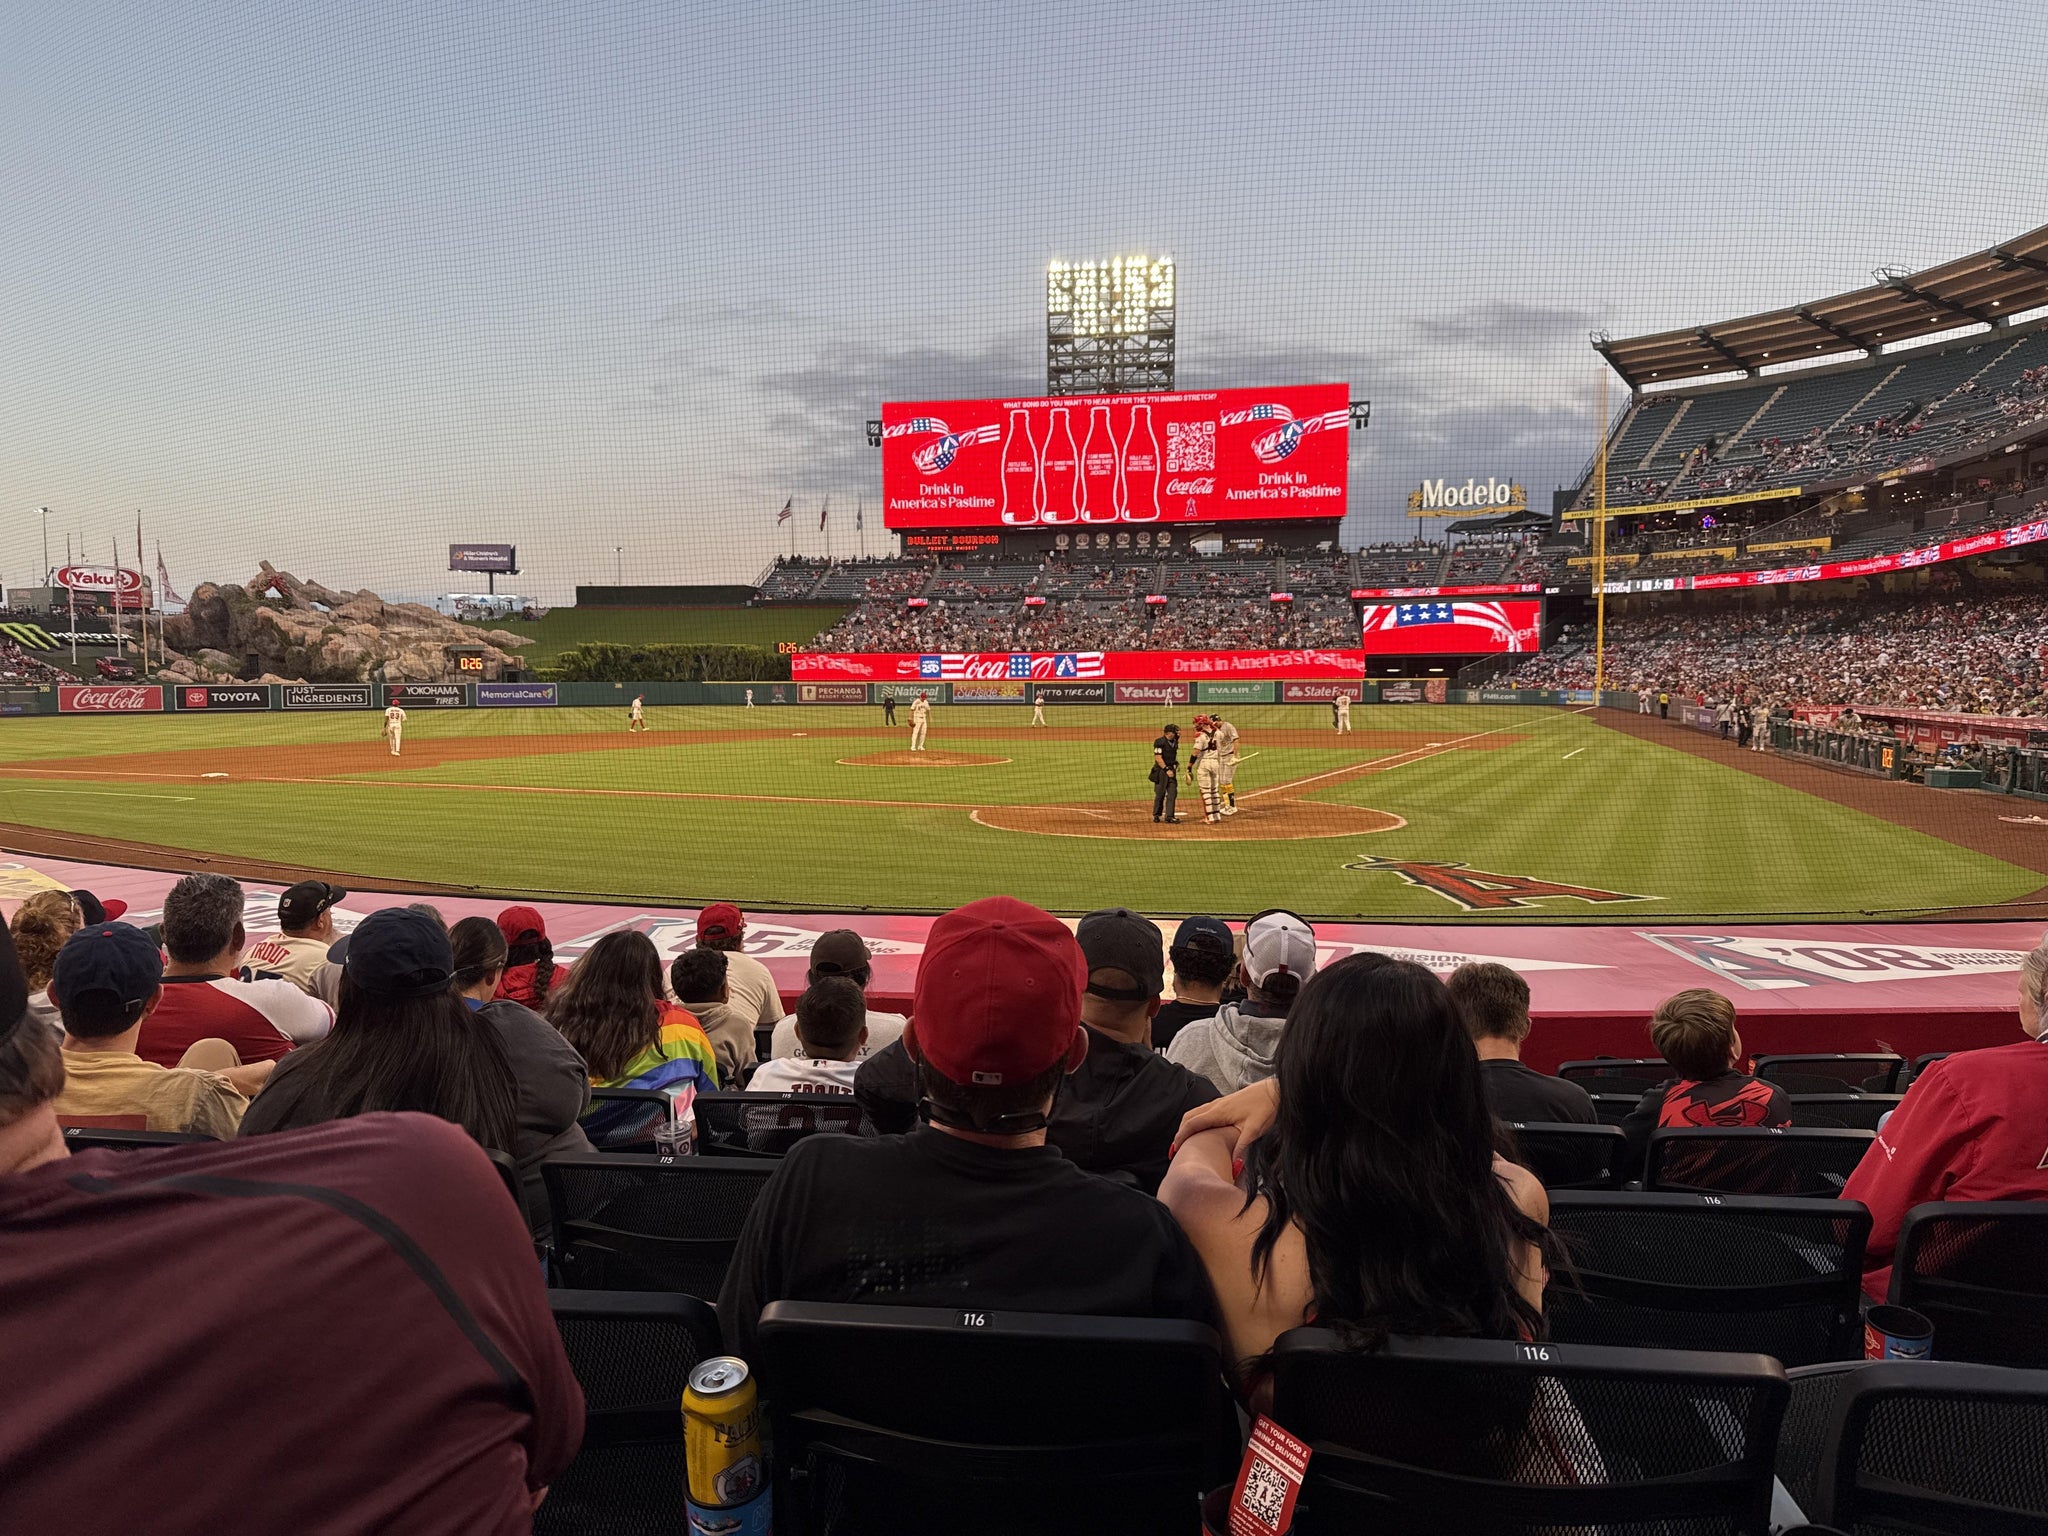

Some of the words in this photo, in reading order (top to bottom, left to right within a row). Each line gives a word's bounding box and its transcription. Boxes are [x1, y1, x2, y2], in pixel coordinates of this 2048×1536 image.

[1003, 401, 1021, 409] WHAT
[1022, 400, 1039, 408] SONG
[1134, 396, 1146, 404] THE
[1184, 393, 1217, 402] STRETCH?
[1258, 472, 1293, 485] Drink
[1296, 472, 1307, 483] in
[920, 483, 951, 495] Drink
[953, 483, 964, 495] in
[1225, 486, 1288, 500] America's
[1290, 484, 1341, 498] Pastime
[1422, 477, 1510, 507] Modelo
[890, 497, 946, 509] America's
[948, 496, 995, 508] Pastime
[71, 572, 129, 586] Yakut
[779, 642, 797, 653] 0:26
[460, 658, 482, 670] 0:26
[1174, 658, 1213, 672] Drink
[1215, 657, 1228, 671] in
[1230, 652, 1302, 669] America's
[1304, 650, 1366, 672] Pastime
[211, 692, 260, 702] TOYOTA
[406, 687, 458, 695] YOKOHAMA
[481, 691, 542, 699] MemorialCare
[894, 686, 939, 697] National
[957, 687, 999, 698] Surfside
[1036, 688, 1062, 696] NITTO
[1064, 688, 1103, 696] TIRE.COM
[73, 687, 149, 709] Coca-Cola
[292, 694, 363, 703] INGREDIENTS
[250, 942, 291, 966] TROUT
[1765, 947, 1954, 971] '08
[660, 1156, 674, 1164] 115
[1704, 1197, 1720, 1205] 116
[964, 1314, 985, 1326] 116
[1524, 1346, 1549, 1361] 116
[1258, 1419, 1269, 1430] GET
[1270, 1426, 1286, 1442] YOUR
[1286, 1437, 1302, 1454] FOOD
[1302, 1450, 1307, 1458] &
[1254, 1428, 1275, 1447] DRINKS
[1275, 1443, 1305, 1469] DELIVERED!
